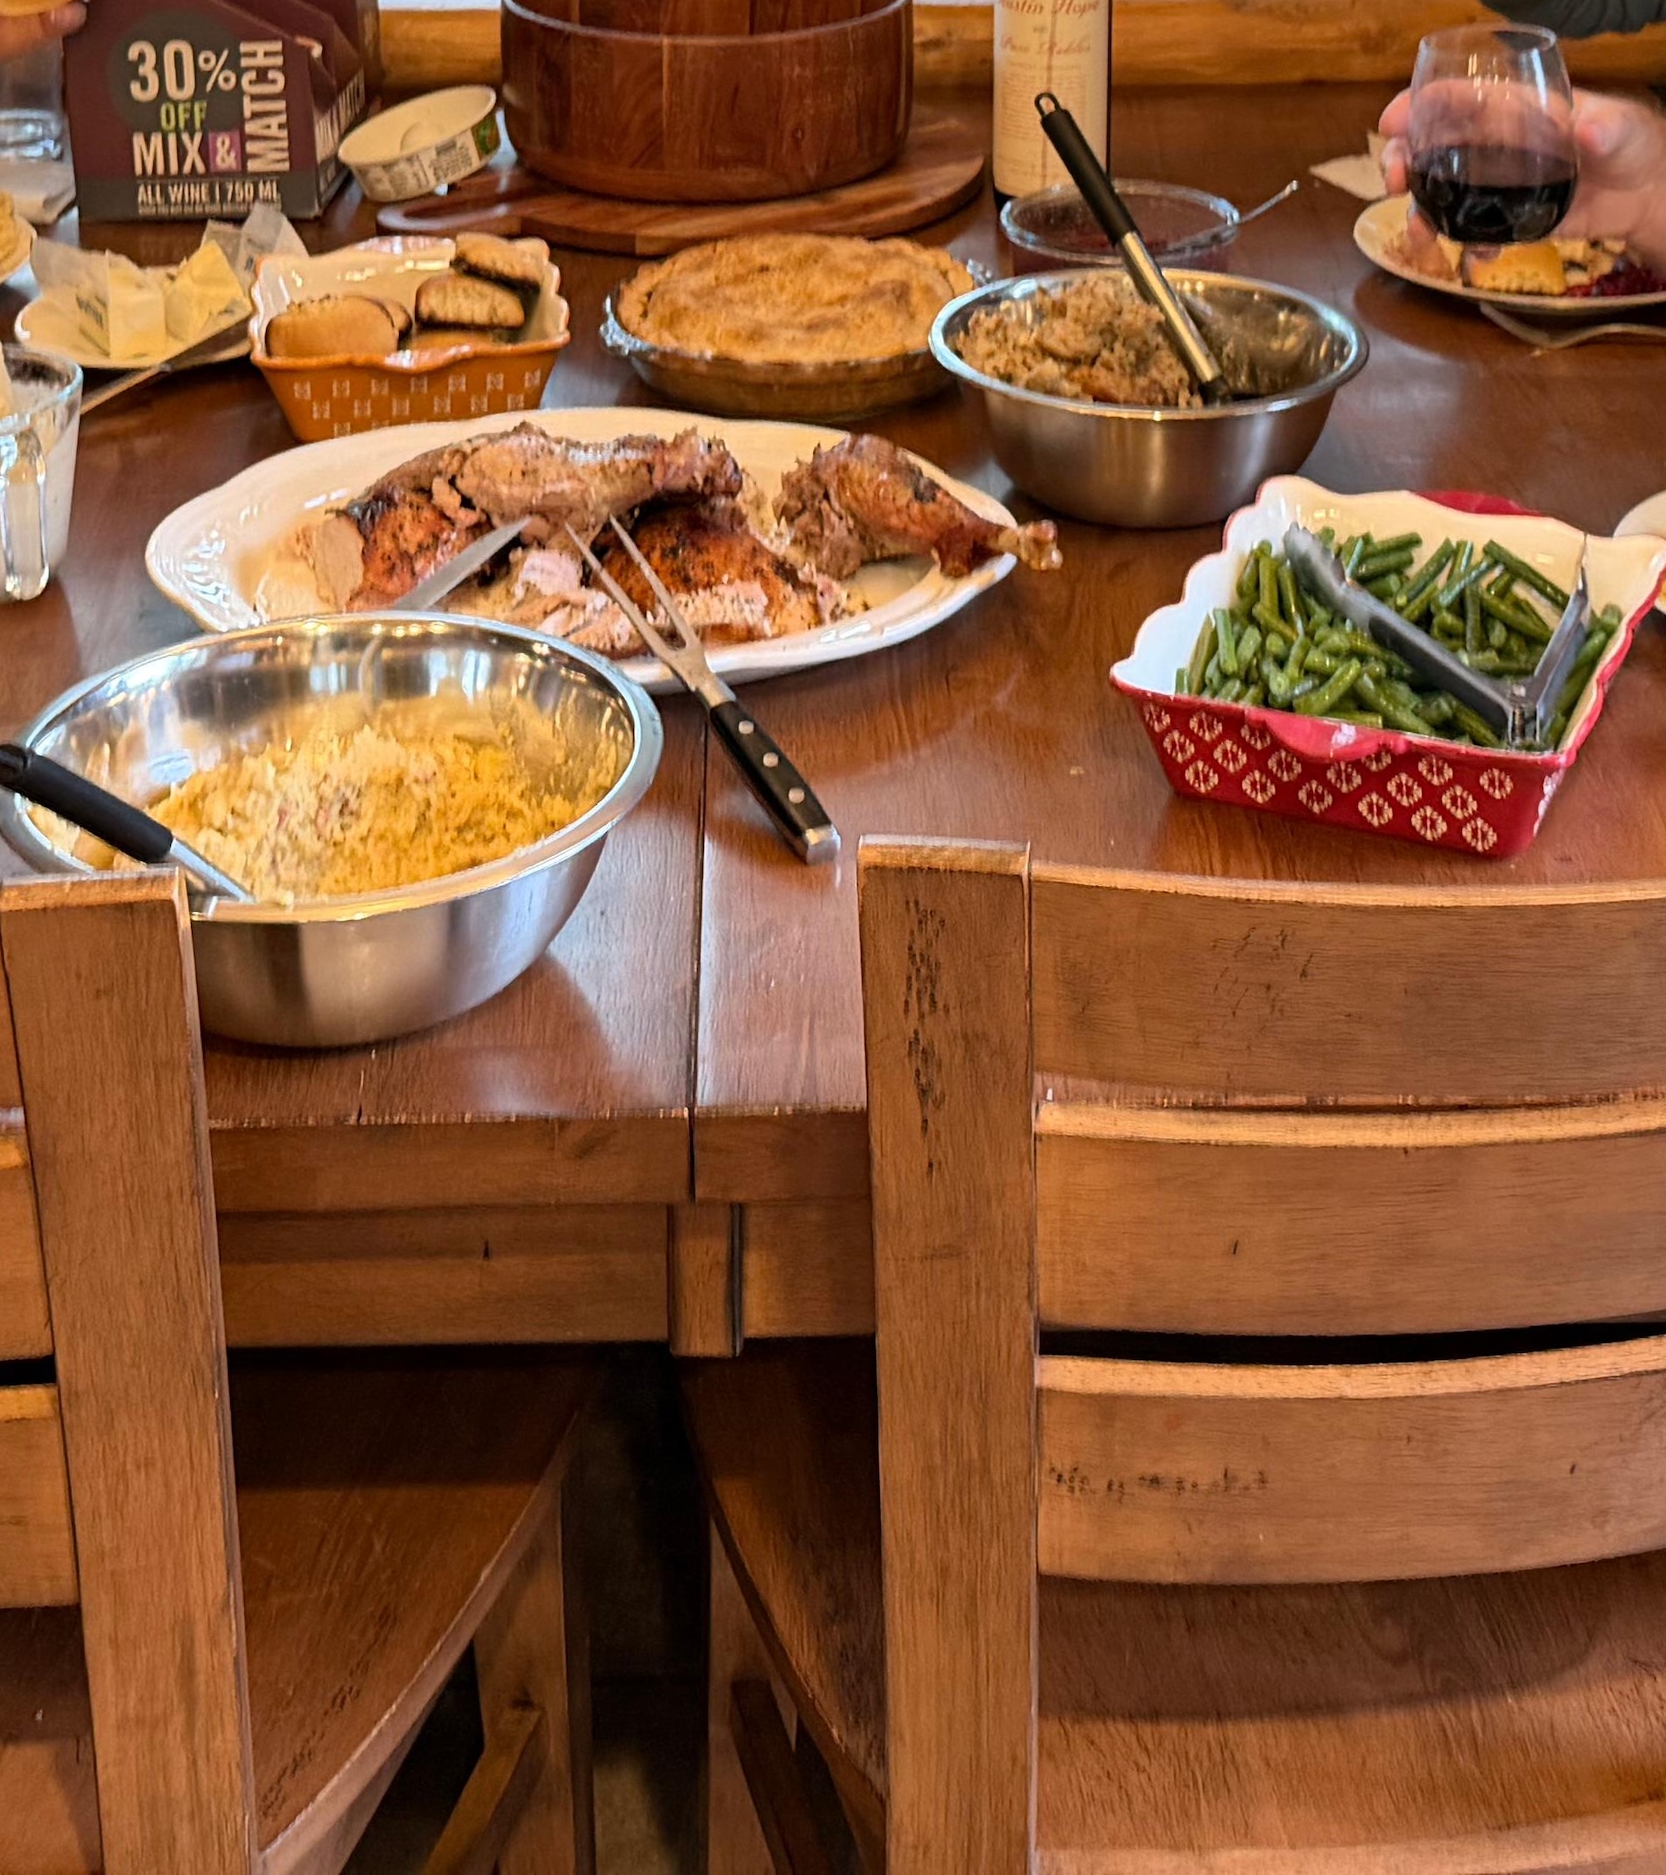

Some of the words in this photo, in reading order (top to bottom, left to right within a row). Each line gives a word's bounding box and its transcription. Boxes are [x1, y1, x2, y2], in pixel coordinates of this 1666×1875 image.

[127, 39, 237, 103] 30%
[132, 131, 207, 176] MIX
[214, 134, 237, 170] &
[239, 39, 290, 173] MATCH
[160, 100, 208, 132] OFF
[137, 182, 165, 205] ALL
[168, 181, 210, 204] WINE
[225, 180, 255, 203] 750
